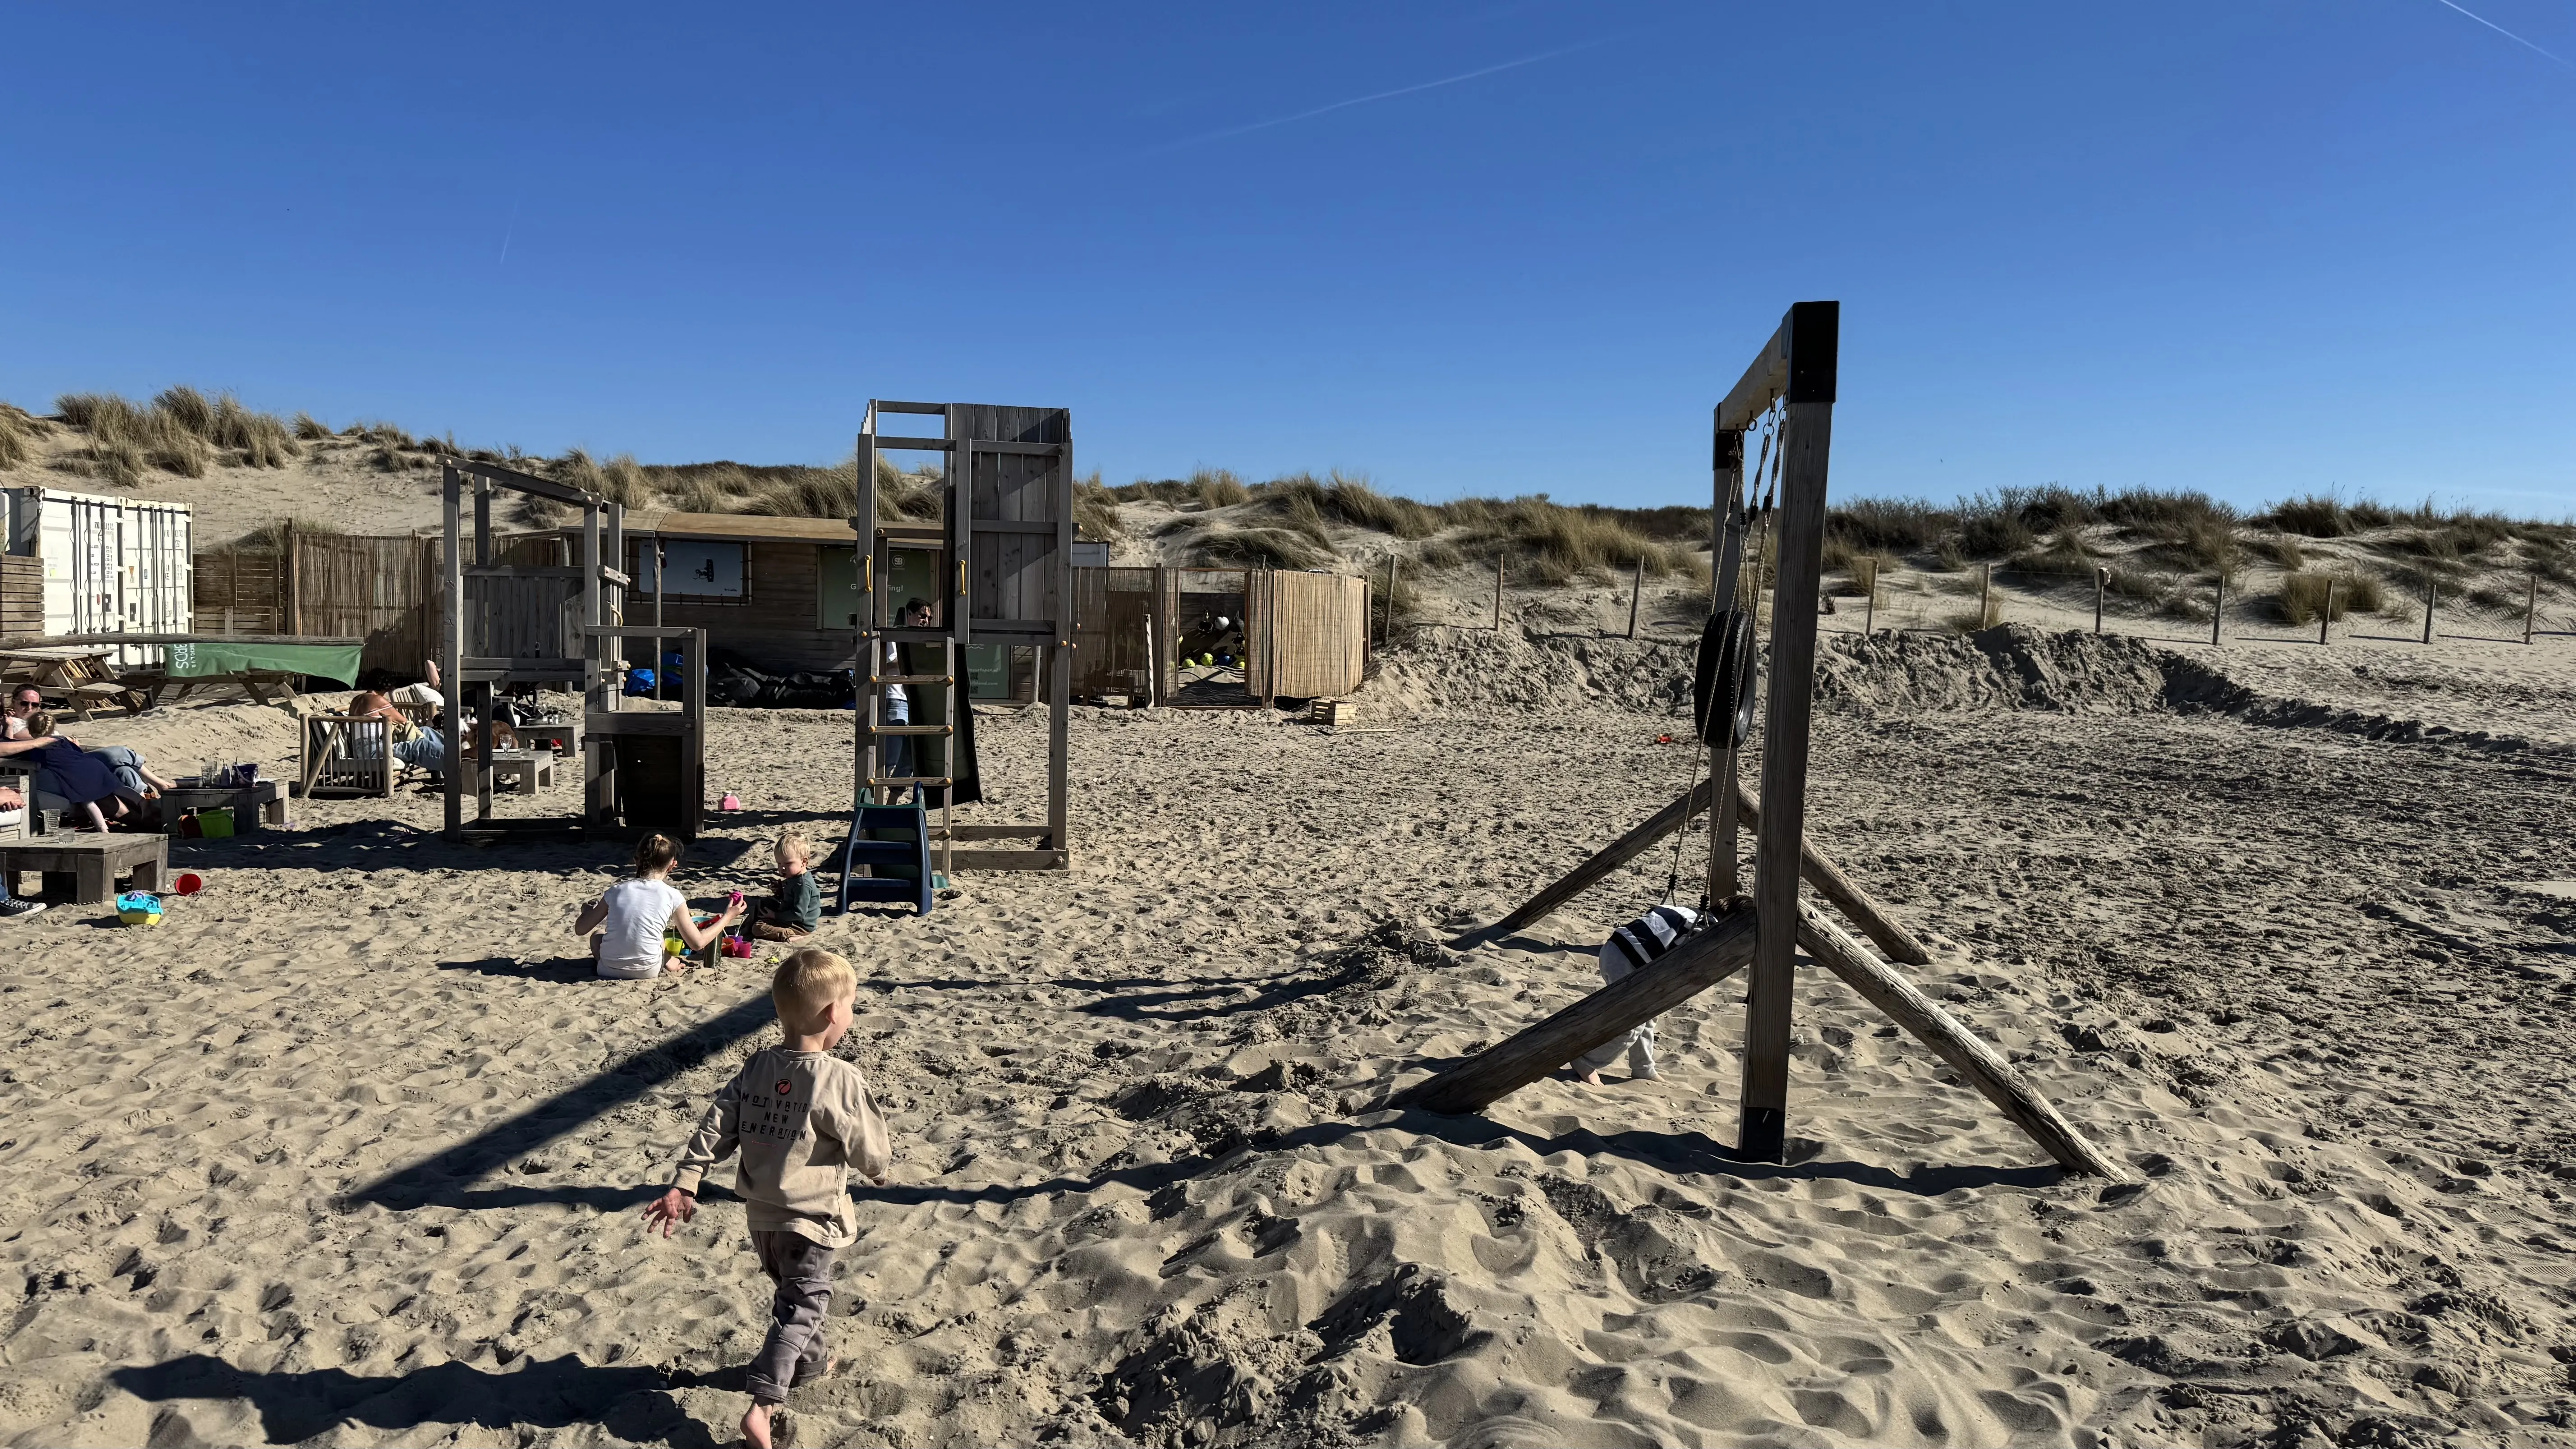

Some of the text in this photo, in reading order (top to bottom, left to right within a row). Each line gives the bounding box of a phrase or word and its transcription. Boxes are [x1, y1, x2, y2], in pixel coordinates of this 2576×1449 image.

[741, 1093, 808, 1112] MOTIVATIO
[764, 1112, 789, 1124] NEW
[741, 1121, 806, 1141] ENERATION
